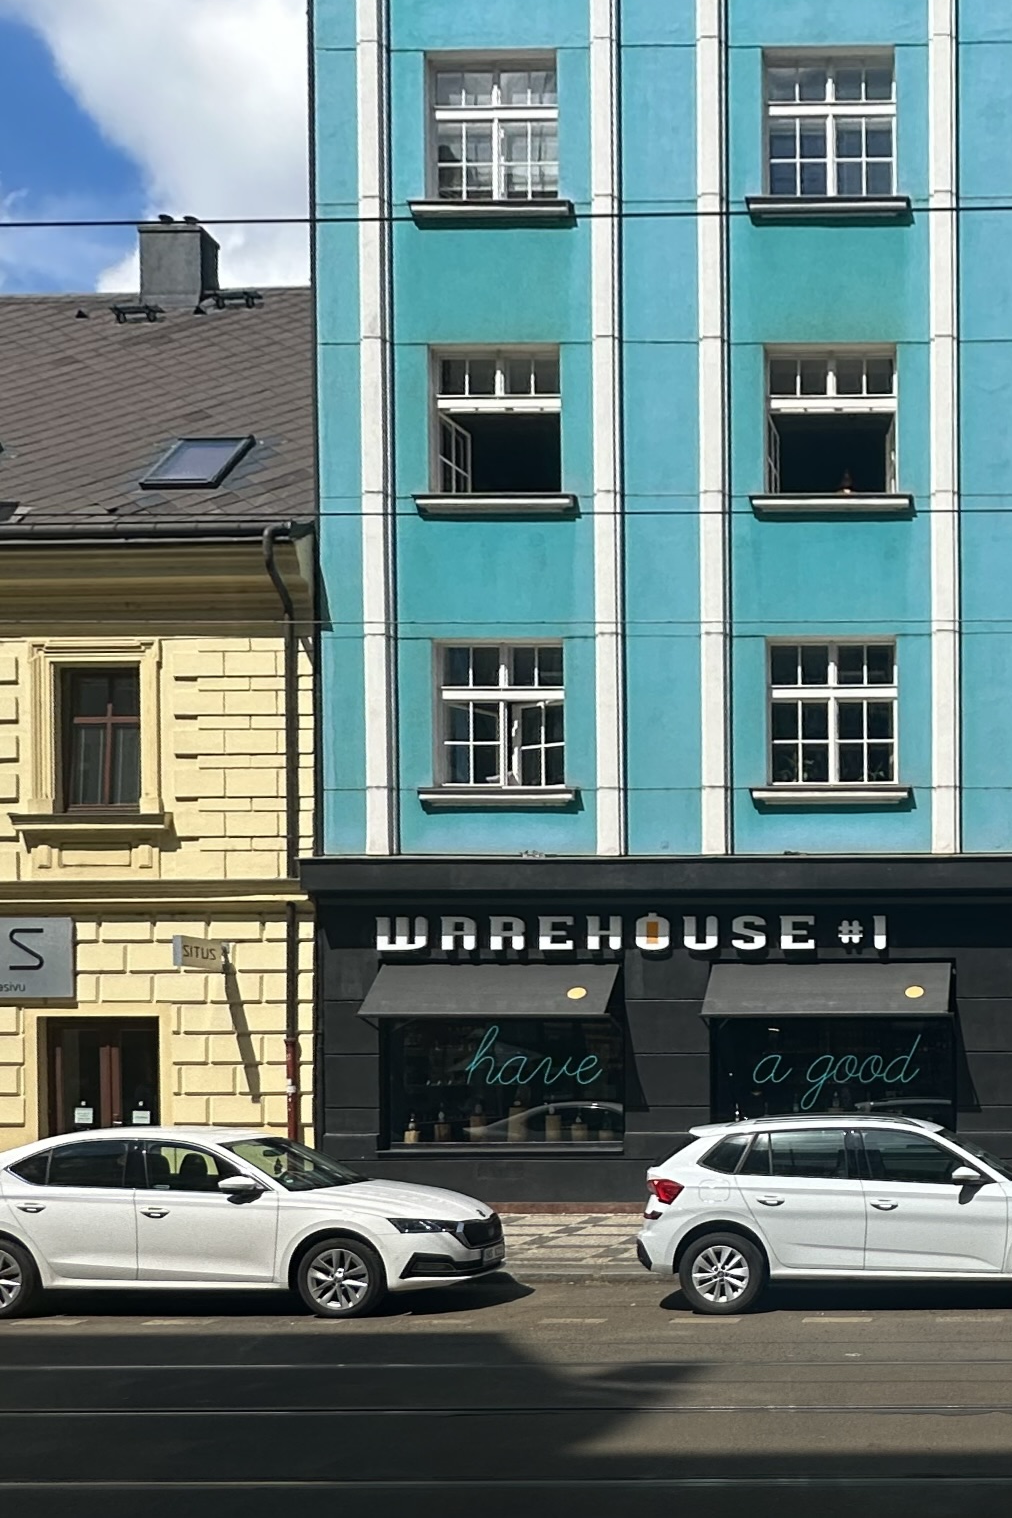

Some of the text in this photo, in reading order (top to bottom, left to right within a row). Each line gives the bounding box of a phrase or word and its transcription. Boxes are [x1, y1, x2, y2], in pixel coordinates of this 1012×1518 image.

[9, 928, 45, 971] S
[182, 944, 217, 961] SITUS
[375, 913, 887, 950] WAREHOUSE #1
[465, 1025, 603, 1084] have
[752, 1034, 921, 1110] a good
